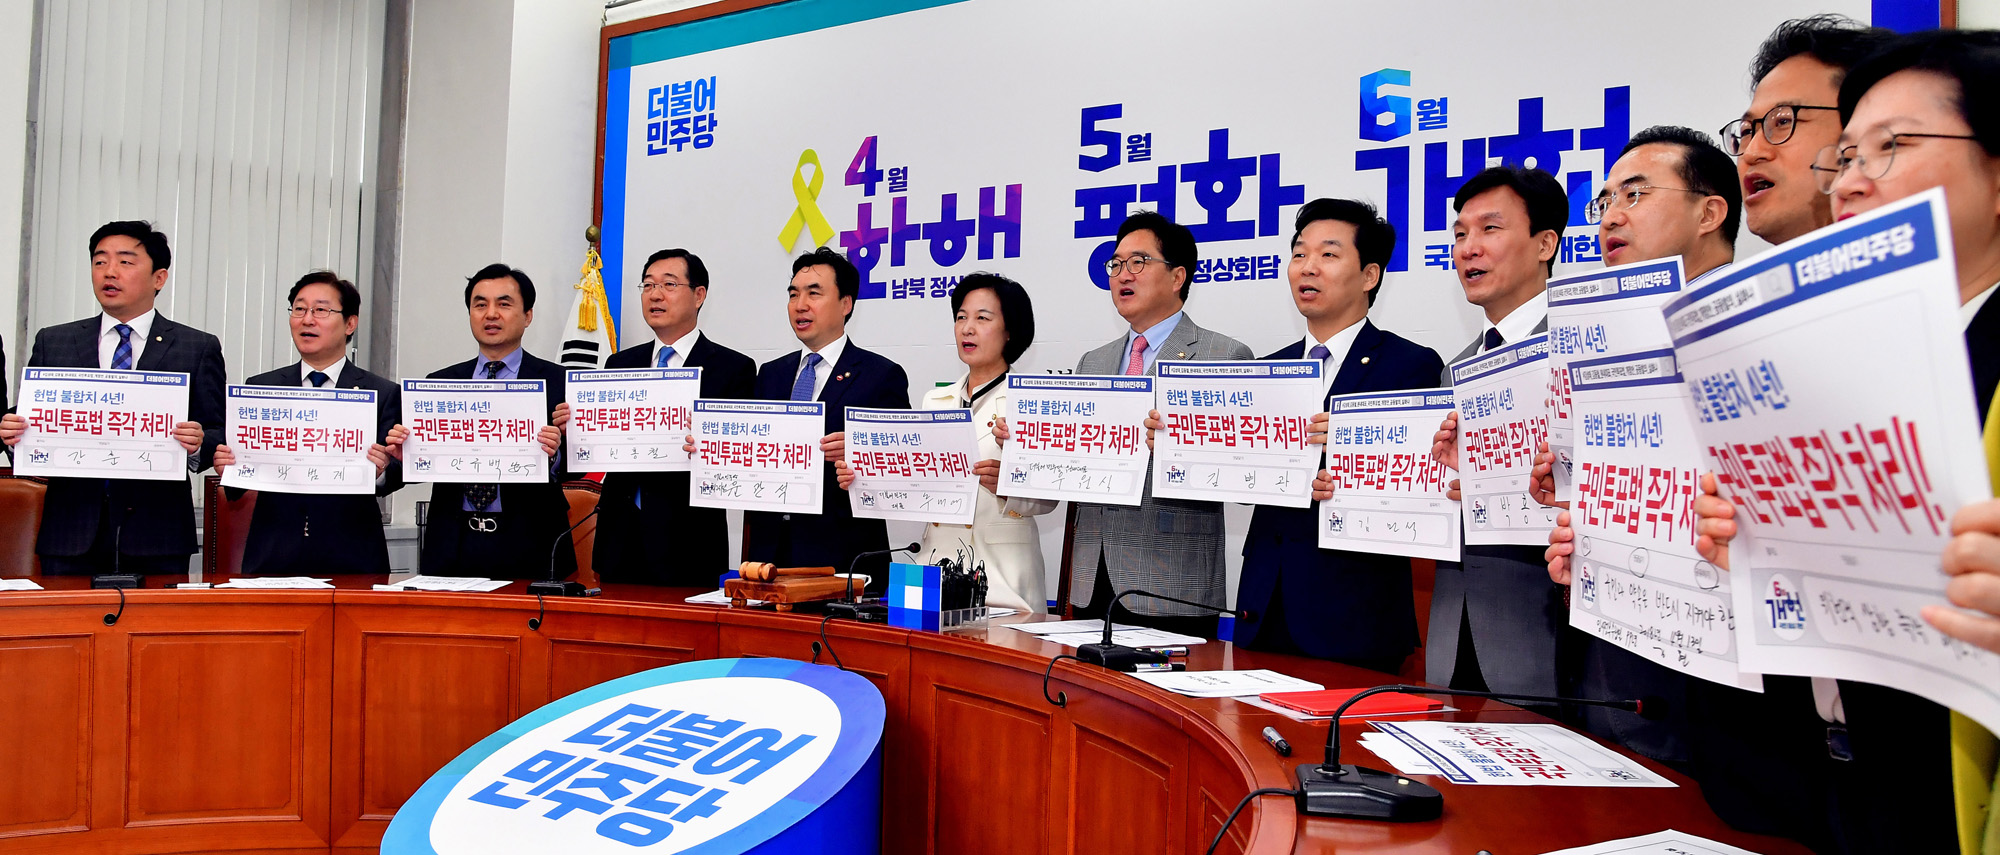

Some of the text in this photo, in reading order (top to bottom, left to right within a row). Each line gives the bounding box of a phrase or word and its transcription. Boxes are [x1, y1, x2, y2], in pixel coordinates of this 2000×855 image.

[647, 75, 717, 120] 더불어
[1359, 68, 1448, 142] 6월
[647, 112, 718, 157] 민주당
[1078, 103, 1152, 173] 5월
[845, 135, 909, 197] 4월
[1355, 85, 1631, 273] 개헌
[1074, 128, 1305, 291] 평화
[840, 183, 1023, 300] 화해
[1795, 222, 1916, 287] 더불어민주당
[1192, 255, 1282, 284] 정상회담
[1620, 270, 1672, 291] 더불어민주당
[892, 277, 926, 300] 남북
[1559, 325, 1584, 354] 불합치
[1585, 324, 1608, 353] 4년!
[146, 374, 182, 385] 더불어민주당
[664, 371, 694, 380] 더불어민주당
[1272, 366, 1313, 375] 더불어민주당
[34, 388, 125, 406] 헌법 불합치 4년!
[337, 392, 371, 402] 더불어민주당
[507, 383, 539, 392] 더불어민주당
[576, 389, 648, 403] 헌법 불합치 4년!
[1113, 381, 1147, 390] 더불어민주당
[1167, 388, 1253, 407] 헌법 불합치 4년!
[1426, 395, 1454, 405] 더불어민주
[1701, 368, 1757, 421] 불합치
[1746, 359, 1791, 410] 4년!
[239, 406, 318, 422] 헌법 불합치 4년!
[414, 400, 491, 414] 헌법 불합치 4년!
[575, 406, 686, 431] 국민투표법 즉각 처리!
[788, 405, 818, 414] 더불어민주당
[934, 413, 966, 421] 더불어민주당
[1017, 399, 1095, 417] 헌법 불합치 4년!
[1461, 387, 1514, 421] 헌법 불합치 4년!
[29, 407, 172, 439] 국민투표법 즉각 처리!
[413, 418, 535, 443] 국민투표법 즉각 처리!
[702, 421, 770, 436] 헌법 불합치 4년!
[1167, 413, 1306, 450] 국민투표법 즉각 처리!
[1335, 425, 1407, 445] 헌법 불합치 4년!
[1584, 411, 1663, 448] 헌법 불합치 4년!
[237, 425, 363, 453] 국민투표법 즉각 처리!
[853, 430, 921, 447] 헌법 불합치 4년!
[1016, 421, 1138, 455] 국민투표법 즉각 처리!
[1466, 422, 1511, 472] 국민투표법
[1509, 418, 1531, 468] 즉각
[700, 440, 811, 470] 국민투표법 즉각 처리!
[852, 451, 970, 479] 국민투표법 즉각 처리!
[1331, 453, 1446, 493] 국민투표법 즉각 처리!
[1708, 415, 1946, 536] 국민투표법 즉각 처리!
[1578, 462, 1644, 534] 국민투표법
[1646, 467, 1678, 542] 즉각
[1765, 592, 1806, 629] 개헌
[562, 703, 818, 785] 더불어
[467, 749, 730, 848] 민주당
